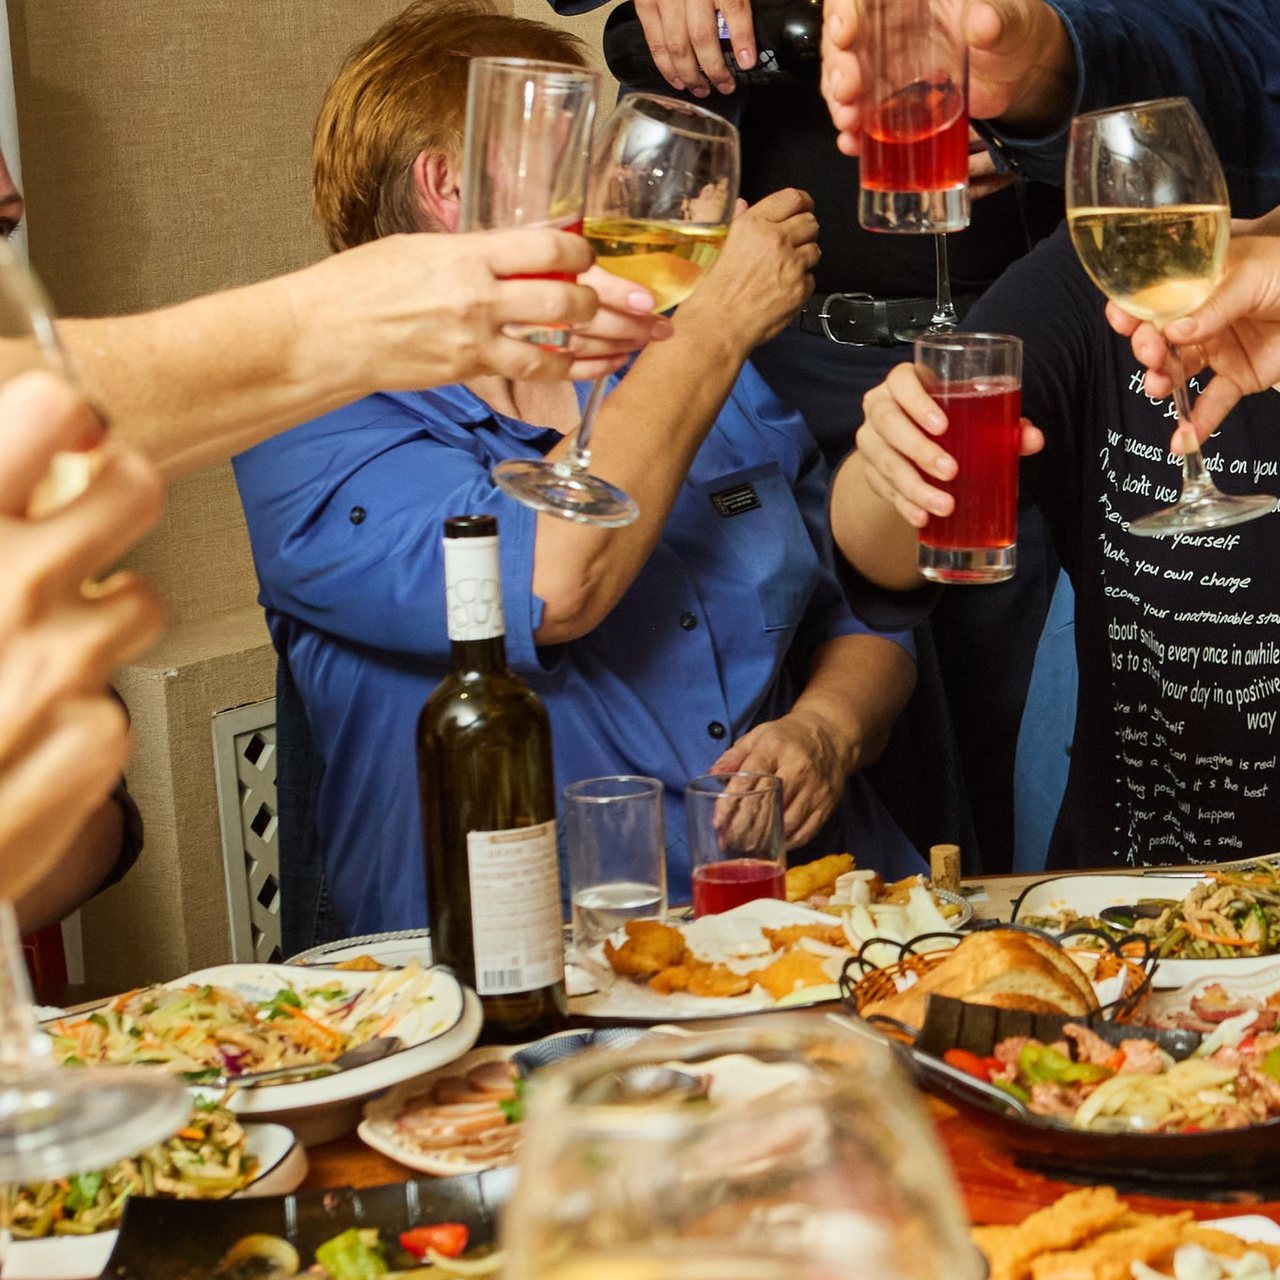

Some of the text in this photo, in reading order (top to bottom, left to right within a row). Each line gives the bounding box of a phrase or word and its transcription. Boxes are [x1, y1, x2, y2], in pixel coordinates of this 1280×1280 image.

[1229, 460, 1247, 474] on
[1253, 459, 1278, 484] you
[1154, 485, 1178, 503] use
[1171, 532, 1240, 551] yourself
[1133, 560, 1160, 577] you
[1163, 569, 1194, 582] own
[1200, 572, 1251, 594] change
[1104, 586, 1140, 606] ecome
[1143, 602, 1170, 619] your
[1108, 616, 1138, 641] about
[1167, 645, 1200, 670] every
[1202, 646, 1229, 665] once
[1231, 643, 1242, 666] in
[1244, 640, 1280, 666] awhile
[1127, 649, 1140, 672] to
[1162, 678, 1188, 701] your
[1190, 679, 1211, 710] day
[1213, 681, 1224, 704] in
[1225, 688, 1233, 706] a
[1246, 710, 1277, 735] way
[1195, 753, 1233, 770] imagine
[1239, 758, 1249, 770] is
[1254, 755, 1276, 771] real
[1243, 782, 1269, 798] best
[1197, 807, 1236, 825] happen
